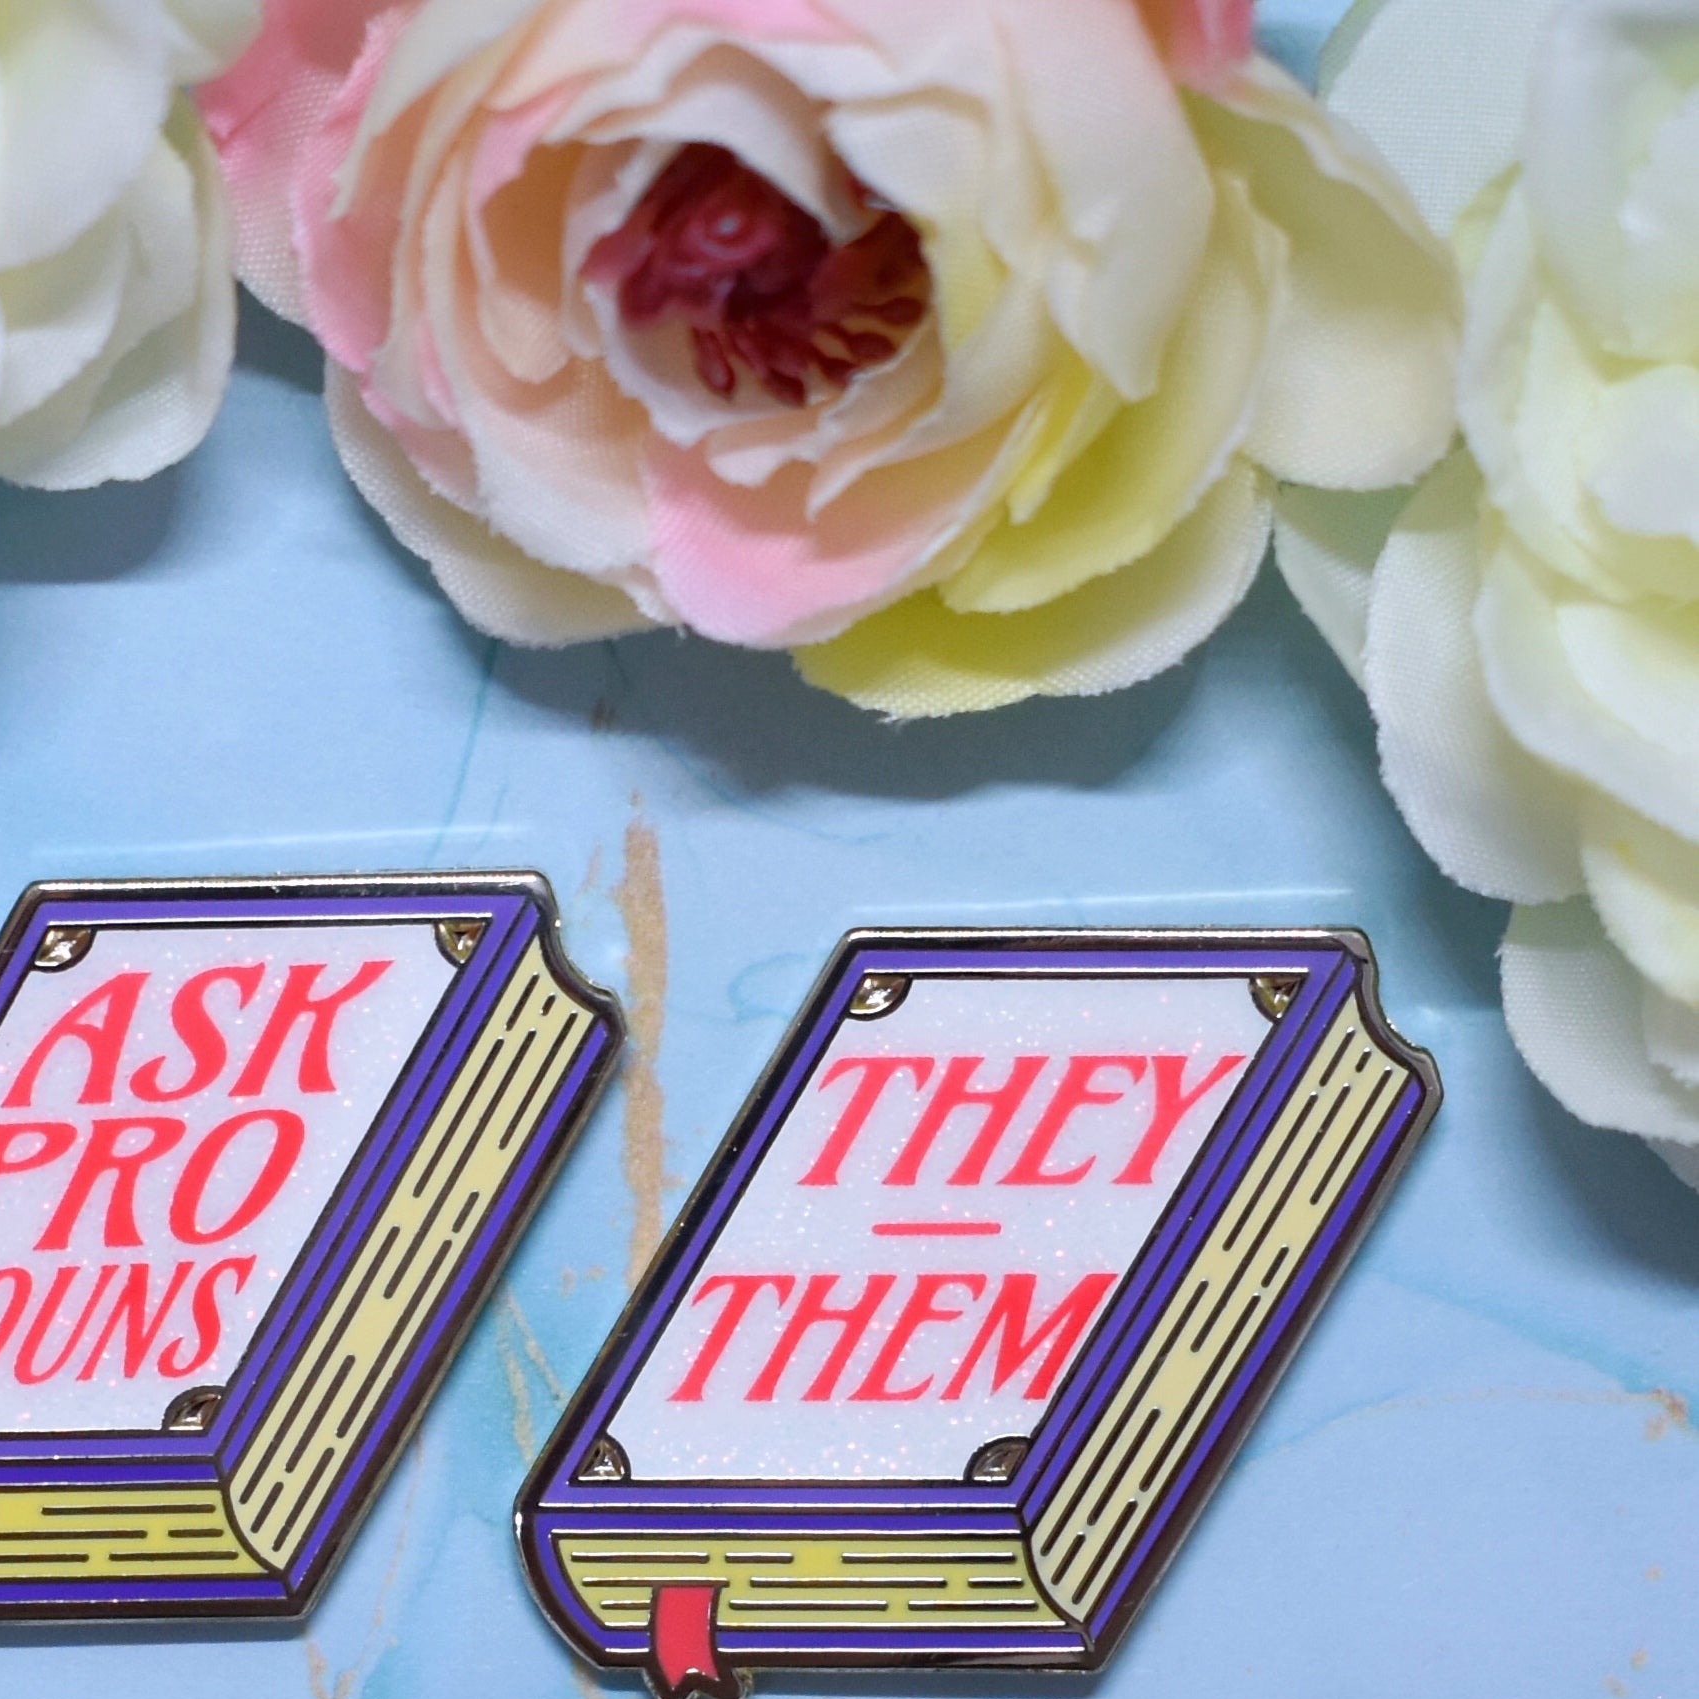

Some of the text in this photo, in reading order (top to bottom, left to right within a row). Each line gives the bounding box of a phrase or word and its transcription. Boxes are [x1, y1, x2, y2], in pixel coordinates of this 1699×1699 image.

[0, 959, 394, 1110] ASK
[799, 1053, 1246, 1188] THEY
[670, 1271, 1119, 1403] THEM
